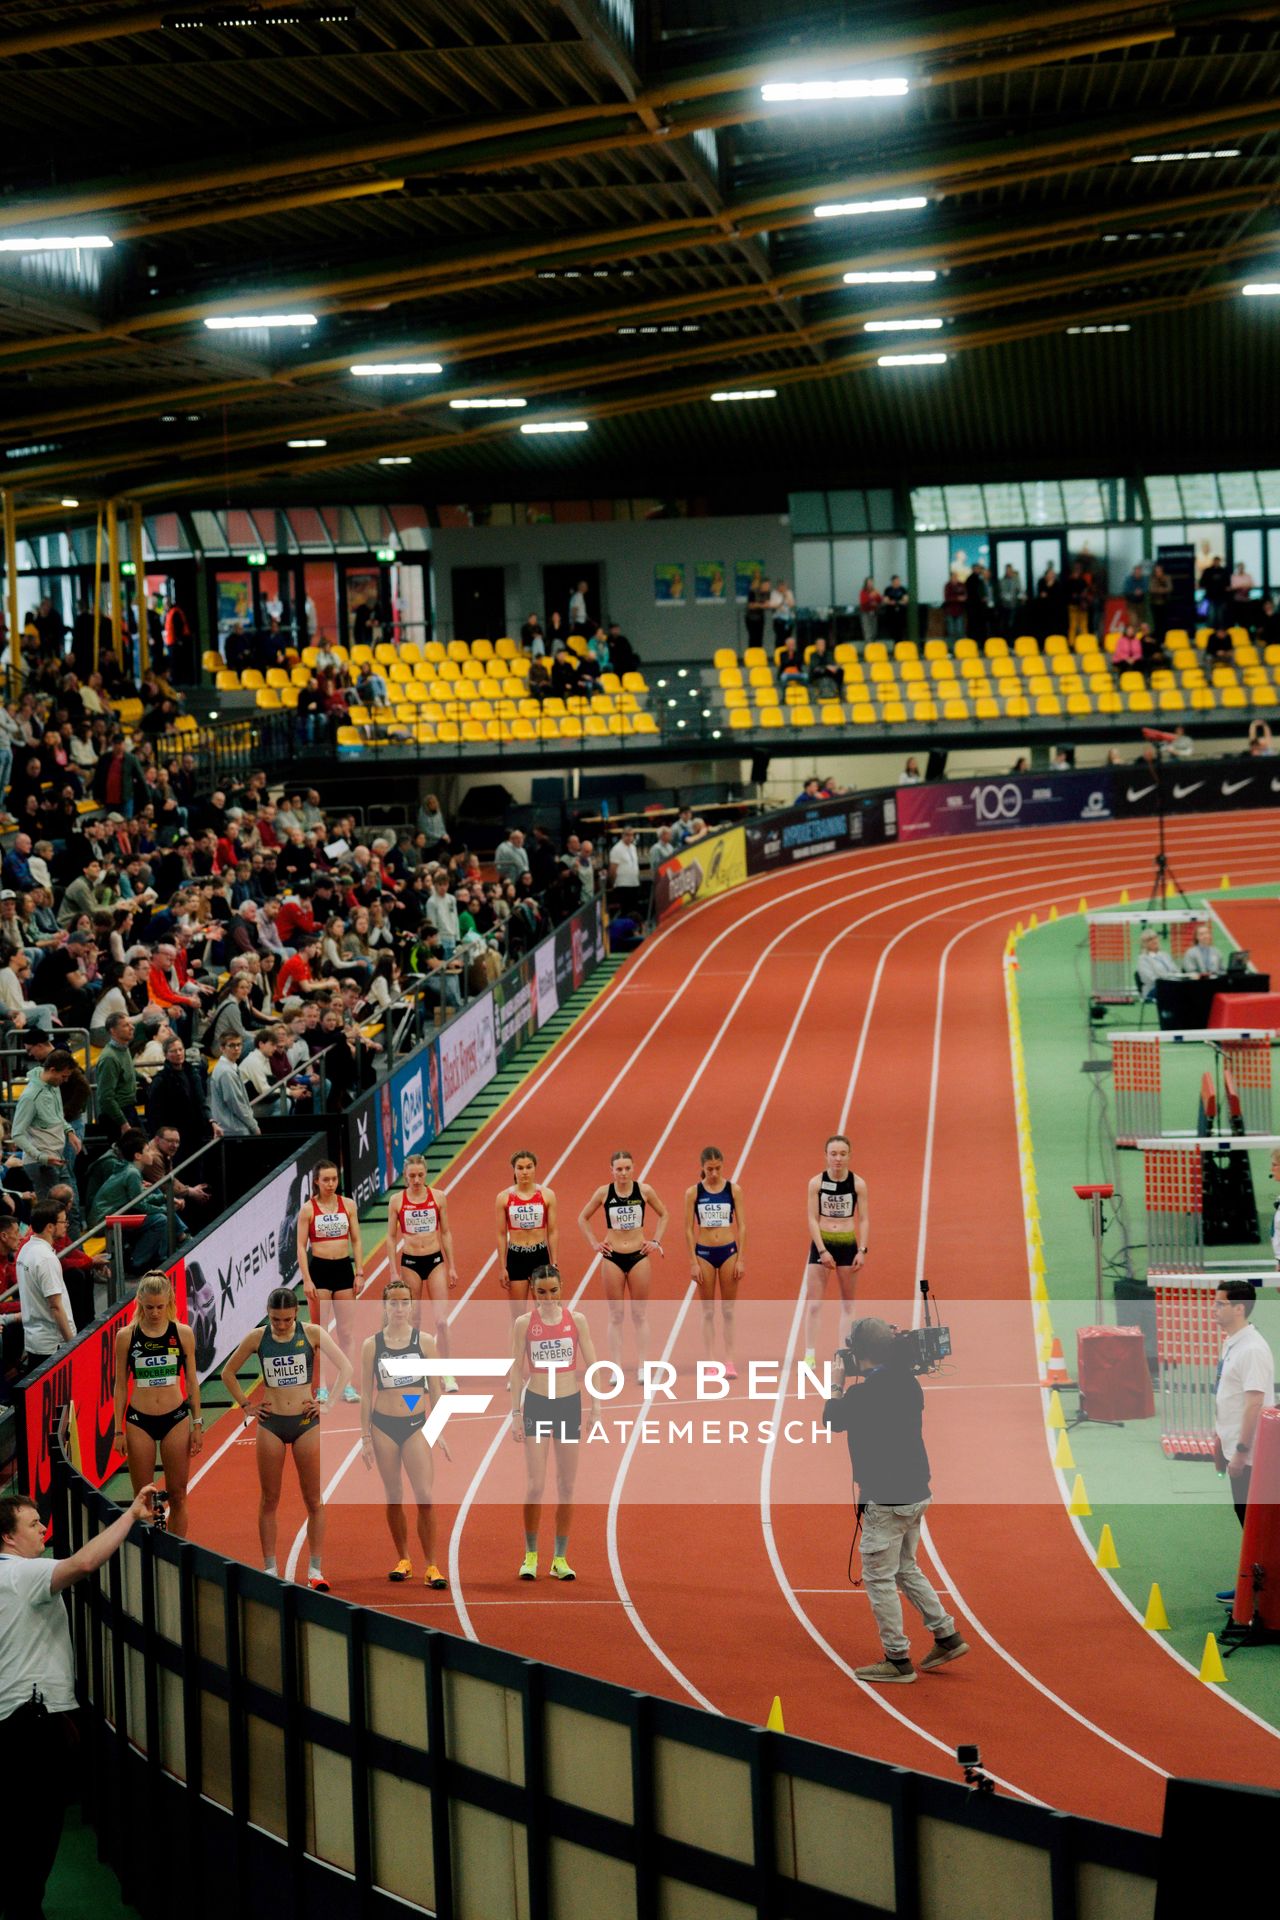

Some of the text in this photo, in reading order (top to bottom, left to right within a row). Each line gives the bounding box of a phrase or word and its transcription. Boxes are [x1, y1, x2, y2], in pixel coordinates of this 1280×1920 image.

[971, 784, 1022, 820] 100
[517, 1205, 534, 1213] GLS
[823, 1201, 850, 1210] EWERT
[323, 1214, 340, 1222] GLS
[411, 1209, 429, 1218] GLS
[514, 1212, 539, 1221] PULTE
[616, 1214, 637, 1222] HOFF
[520, 1244, 537, 1253] PRO
[235, 1231, 276, 1293] XPENG
[540, 1340, 562, 1350] GLS
[532, 1347, 573, 1361] MEYBERG
[145, 1355, 167, 1367] GLS
[273, 1356, 295, 1367] GLS
[138, 1367, 176, 1379] KOLBERG
[266, 1364, 305, 1378] L.MILLER
